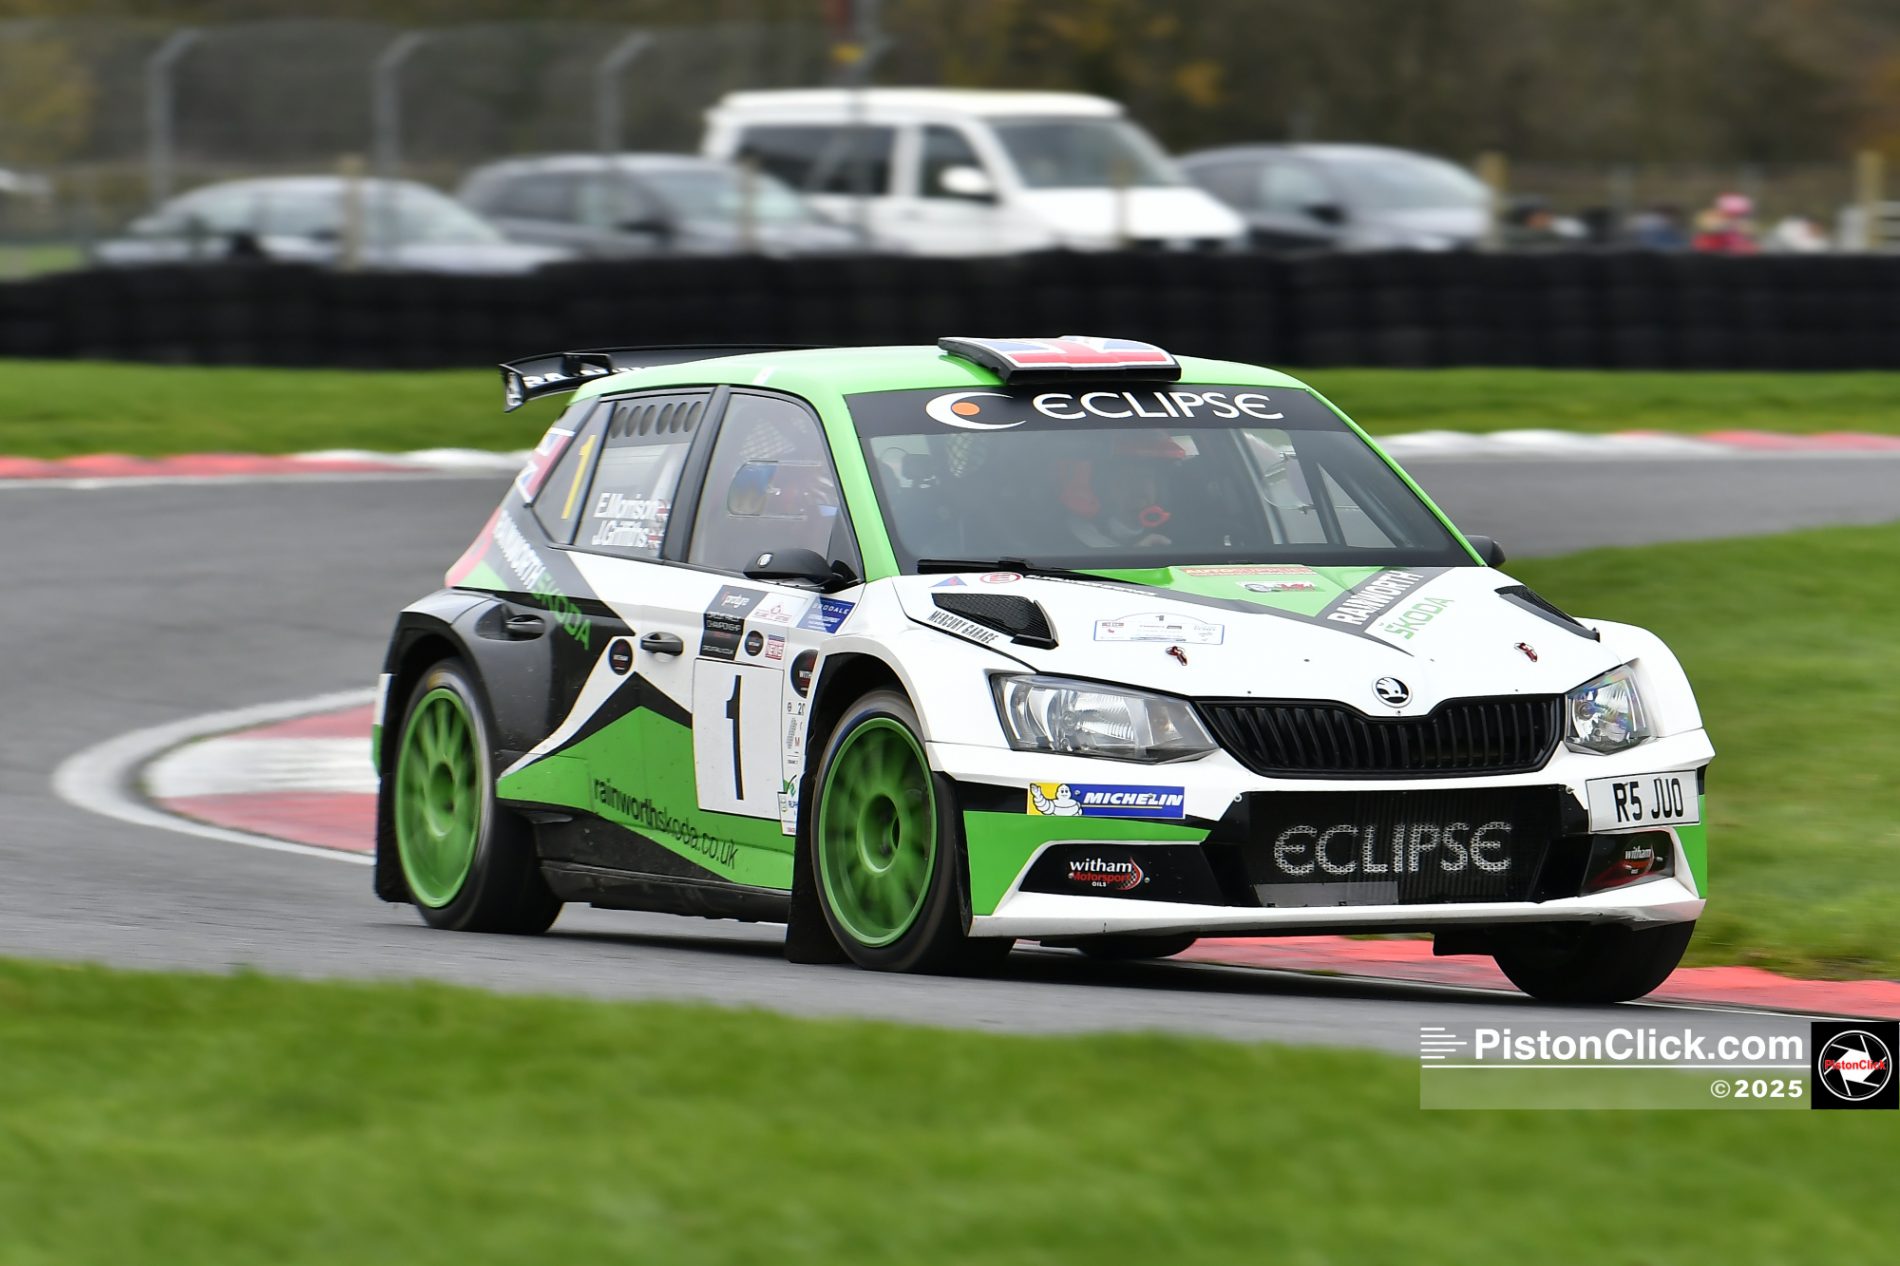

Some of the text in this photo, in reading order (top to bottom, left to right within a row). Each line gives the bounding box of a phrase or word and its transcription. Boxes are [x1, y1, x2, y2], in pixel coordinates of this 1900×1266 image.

[1033, 392, 1284, 420] ECLIPSE
[560, 434, 597, 520] 1
[1326, 569, 1424, 625] RAINWORTH
[928, 610, 998, 644] MERCURY GARAGE
[726, 674, 745, 801] 1
[1083, 792, 1183, 806] MICHELIN
[1612, 781, 1642, 823] R5
[594, 778, 739, 870] rainworthskoda.co.uk
[1274, 821, 1513, 875] ECLIPSE
[1069, 858, 1132, 873] witham
